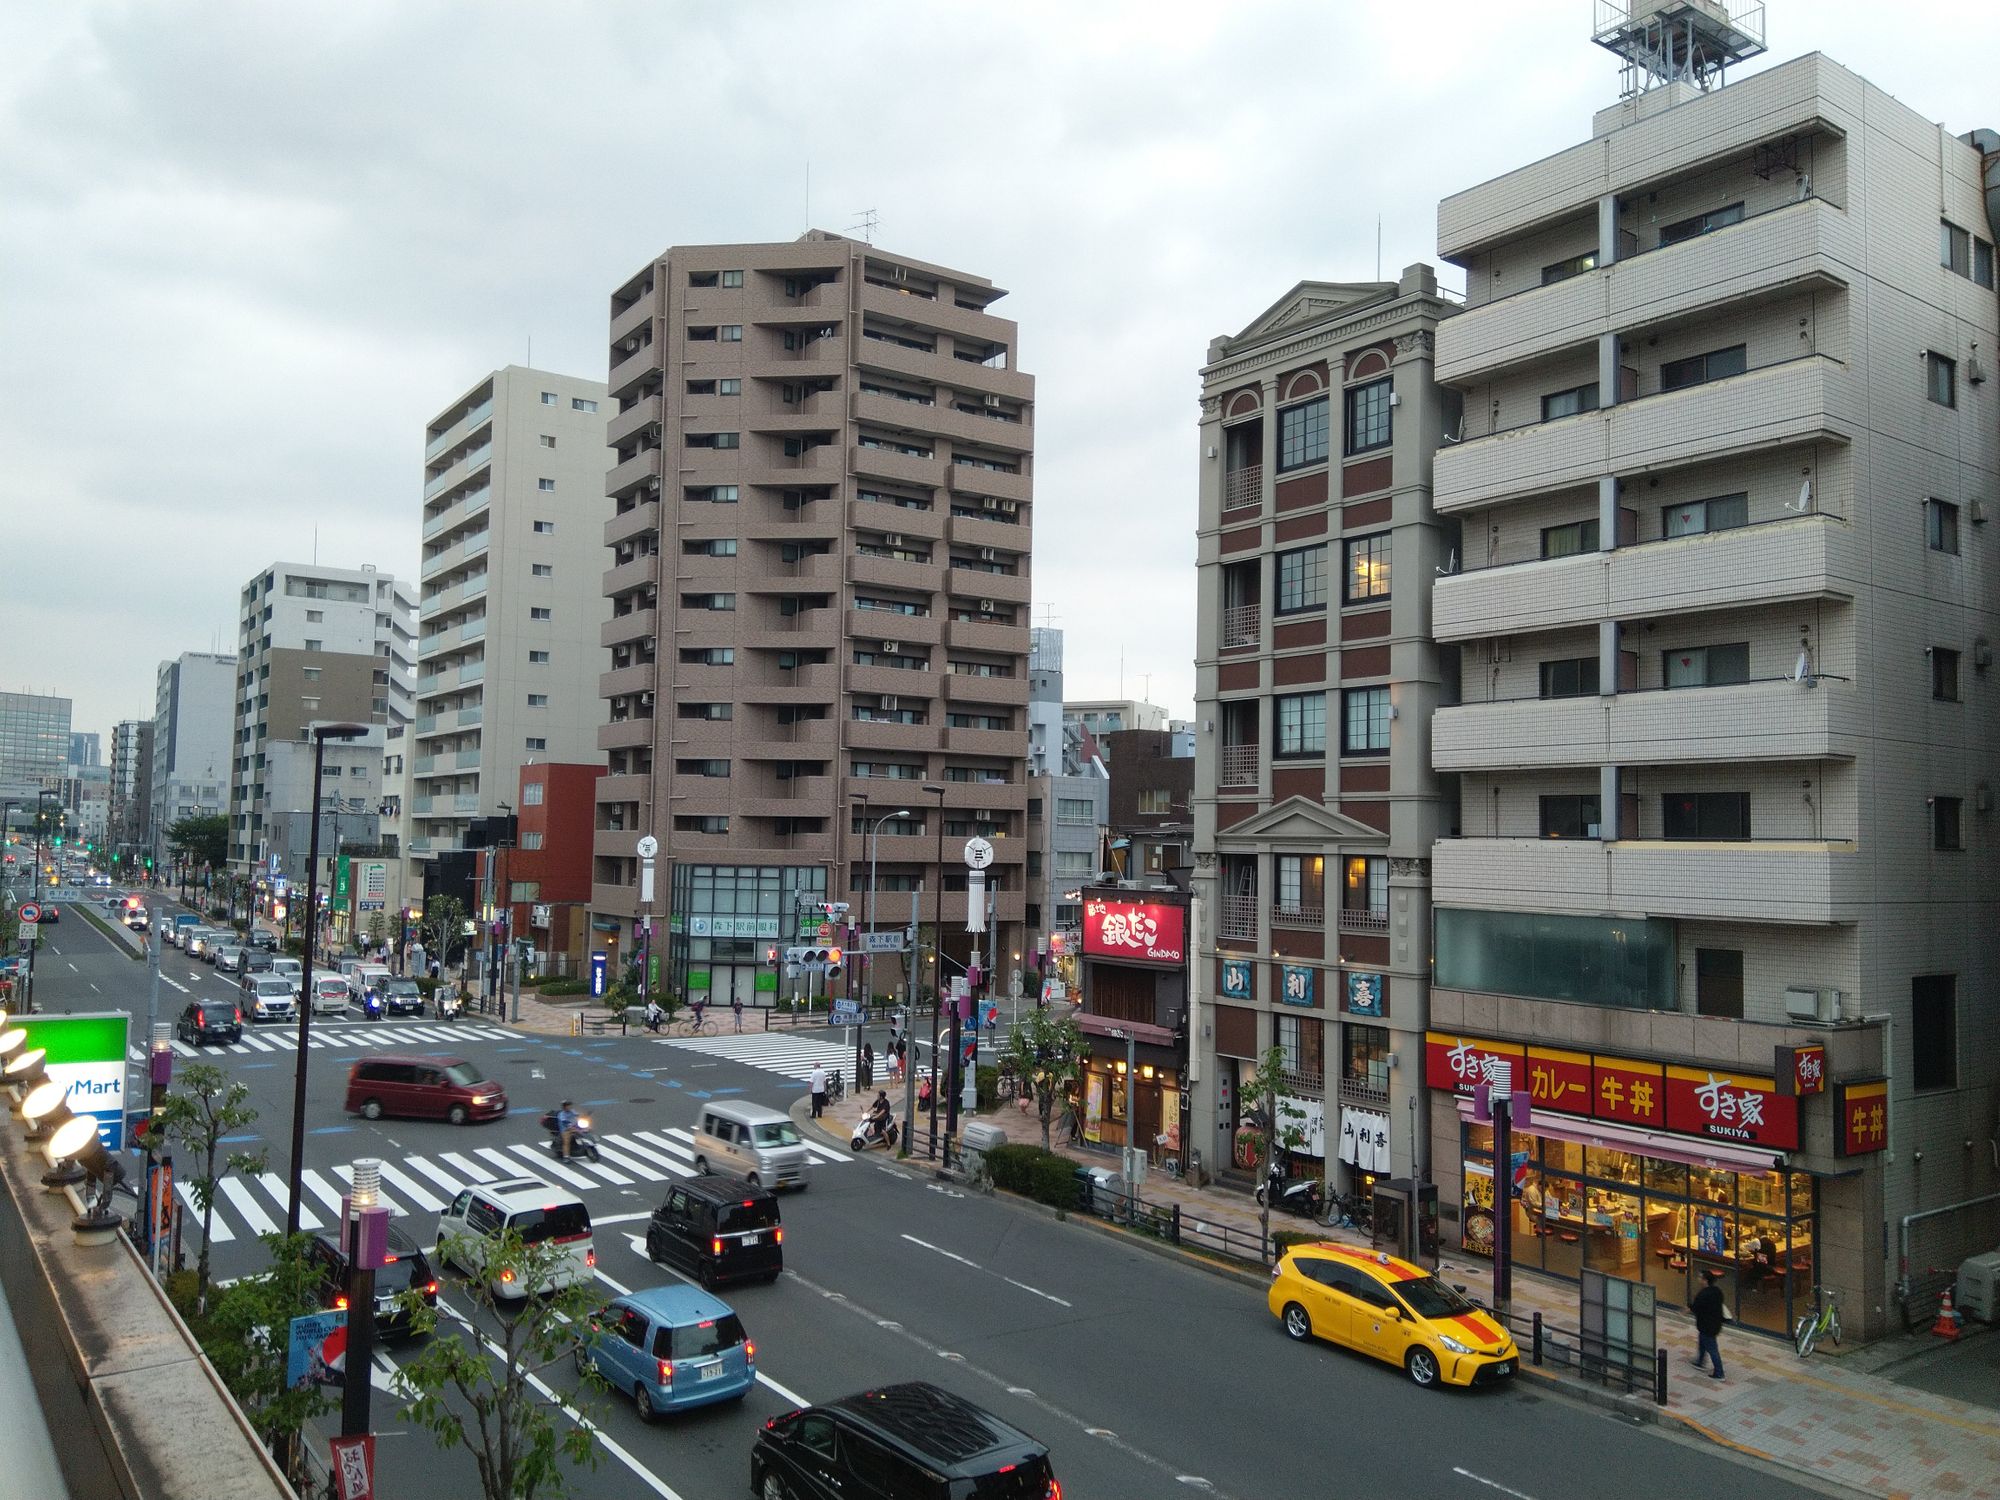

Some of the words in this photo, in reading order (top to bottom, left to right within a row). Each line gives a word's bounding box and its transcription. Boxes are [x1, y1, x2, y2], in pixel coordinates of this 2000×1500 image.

[714, 921, 777, 932] 森下駅前眼科
[868, 934, 900, 943] 森下駅前
[1101, 907, 1158, 948] 銀だこ
[1147, 947, 1180, 959] GINDACO
[1227, 967, 1244, 991] 山
[1287, 973, 1305, 999] 利
[1353, 981, 1374, 1007] 喜
[1532, 1065, 1586, 1100] カレー
[1799, 1053, 1821, 1082] すき家
[1601, 1076, 1654, 1116] 牛丼
[1694, 1072, 1764, 1128] すき家
[1344, 1122, 1388, 1148] 山利喜
[1709, 1124, 1750, 1139] SUKIYA
[1852, 1103, 1884, 1144] 牛丼
